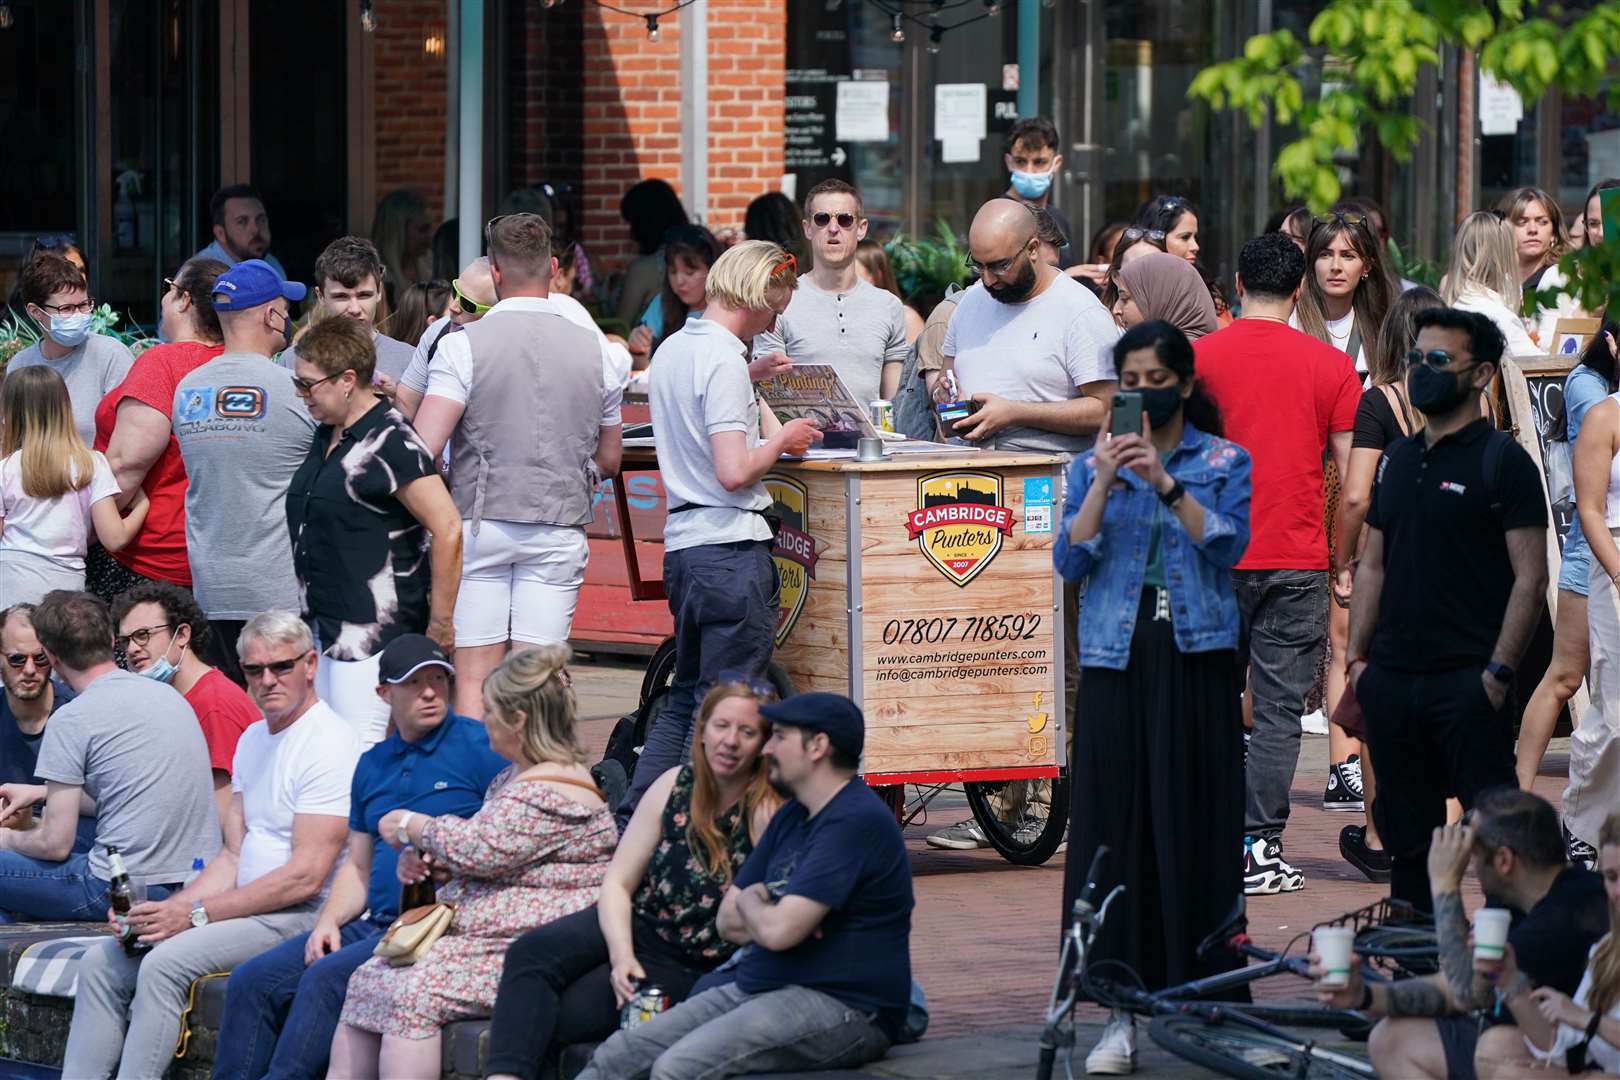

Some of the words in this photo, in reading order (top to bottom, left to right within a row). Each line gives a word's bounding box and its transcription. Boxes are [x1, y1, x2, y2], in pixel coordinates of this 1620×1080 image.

[914, 507, 1006, 526] CAMBRIDGE
[776, 530, 811, 560] RIDGE
[931, 528, 994, 550] Punters
[952, 561, 969, 569] 2007
[778, 566, 800, 589] ters
[882, 617, 957, 645] 07807
[961, 614, 1041, 642] 718592
[877, 650, 1046, 665] www.cambridgepunters.com
[875, 665, 1048, 683] info@cambridgepunters.com
